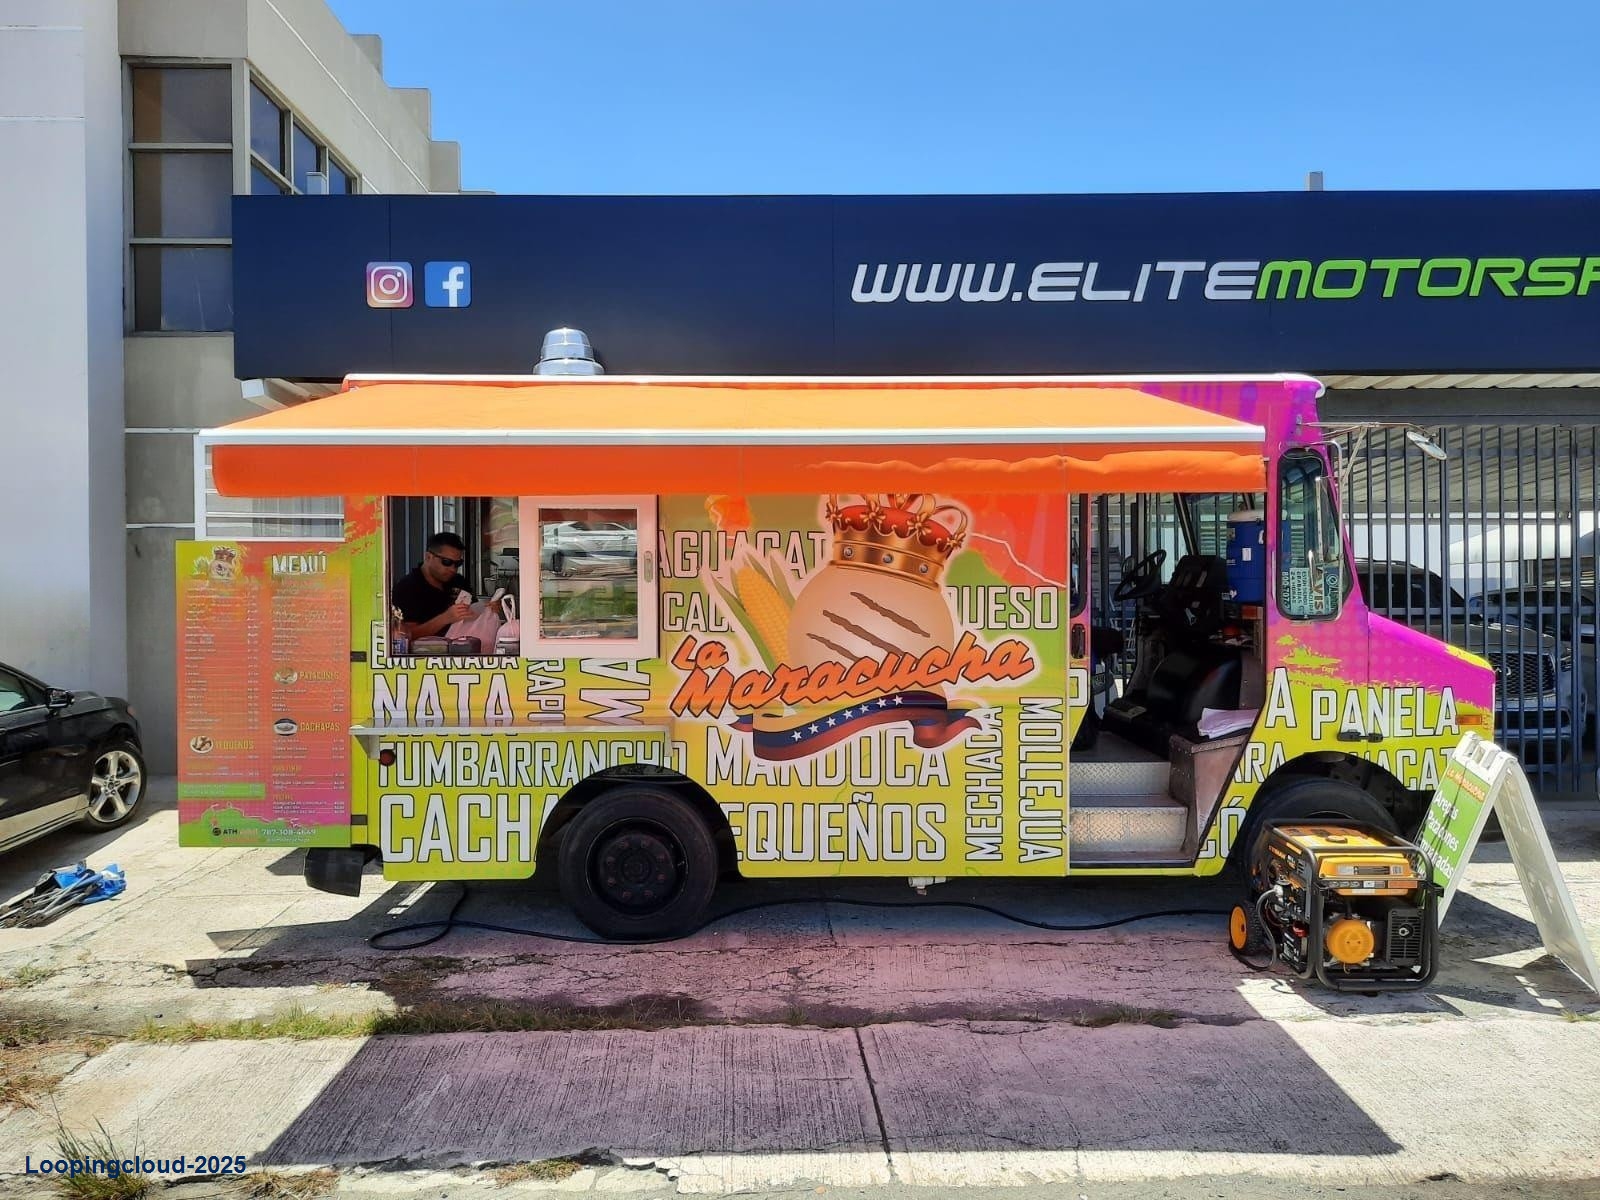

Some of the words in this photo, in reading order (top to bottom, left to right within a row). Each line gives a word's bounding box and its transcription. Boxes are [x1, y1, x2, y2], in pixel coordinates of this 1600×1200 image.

[272, 551, 327, 574] MENÚ
[670, 631, 1035, 719] Maracucha
[671, 635, 729, 670] La
[300, 722, 340, 732] CACHAPAS
[372, 673, 515, 729] NATA
[1311, 686, 1459, 740] PANELA
[964, 706, 1003, 861] MECHADA
[1018, 696, 1066, 863] MOLLEJÚA
